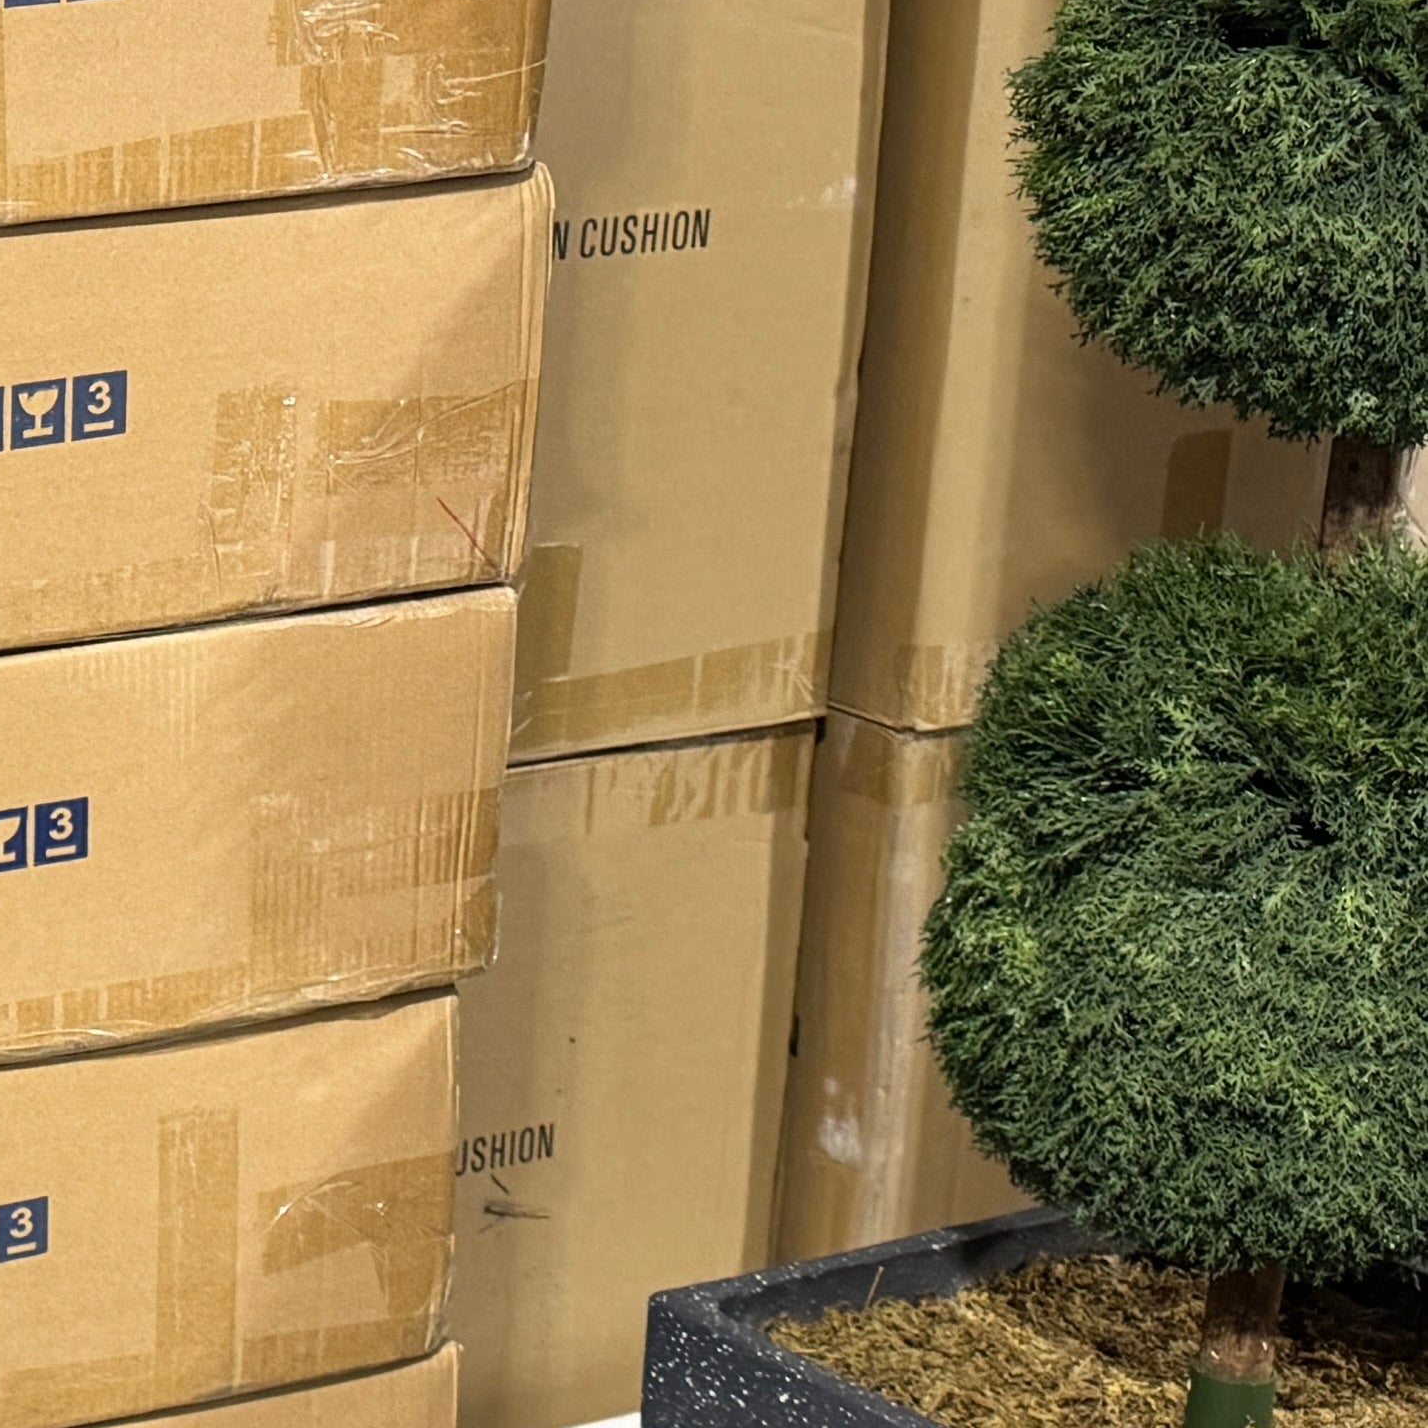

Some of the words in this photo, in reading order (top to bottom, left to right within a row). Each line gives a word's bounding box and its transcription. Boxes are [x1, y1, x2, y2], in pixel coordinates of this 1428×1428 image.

[580, 208, 711, 259] CUSHION
[87, 380, 112, 416] 3
[48, 807, 74, 841] 3
[9, 1207, 34, 1239] 3
